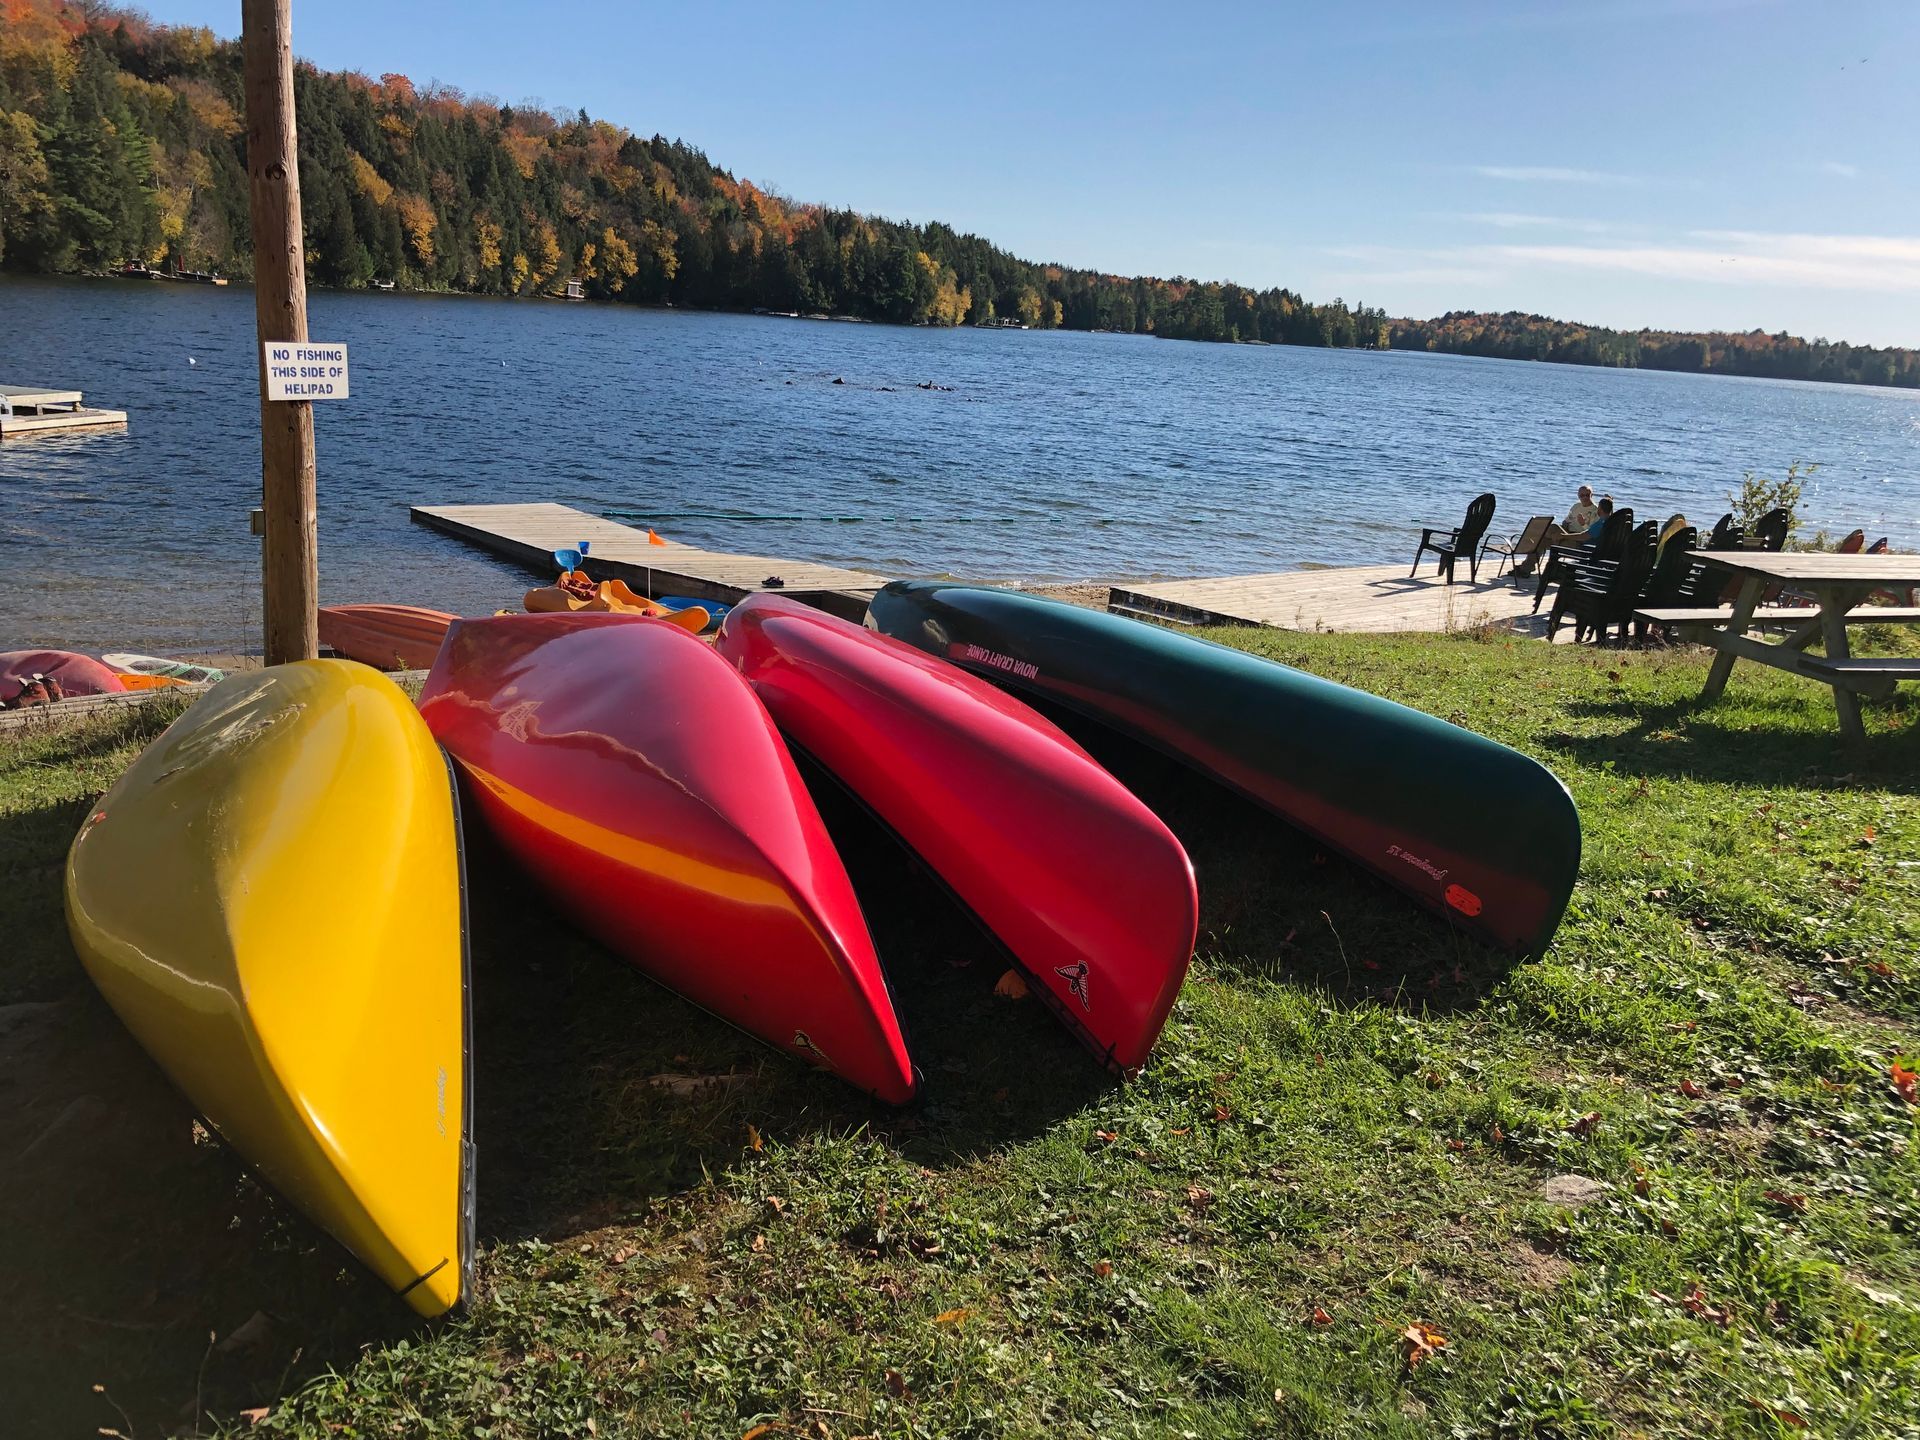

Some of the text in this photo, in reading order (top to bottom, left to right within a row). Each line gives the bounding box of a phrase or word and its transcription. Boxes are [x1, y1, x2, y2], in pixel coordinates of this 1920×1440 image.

[273, 349, 343, 361] NO FISHING
[271, 366, 343, 378] THIS SIDE OF
[284, 383, 333, 395] HELIPAD
[966, 643, 1039, 679] NOVA CRAFT CANOE
